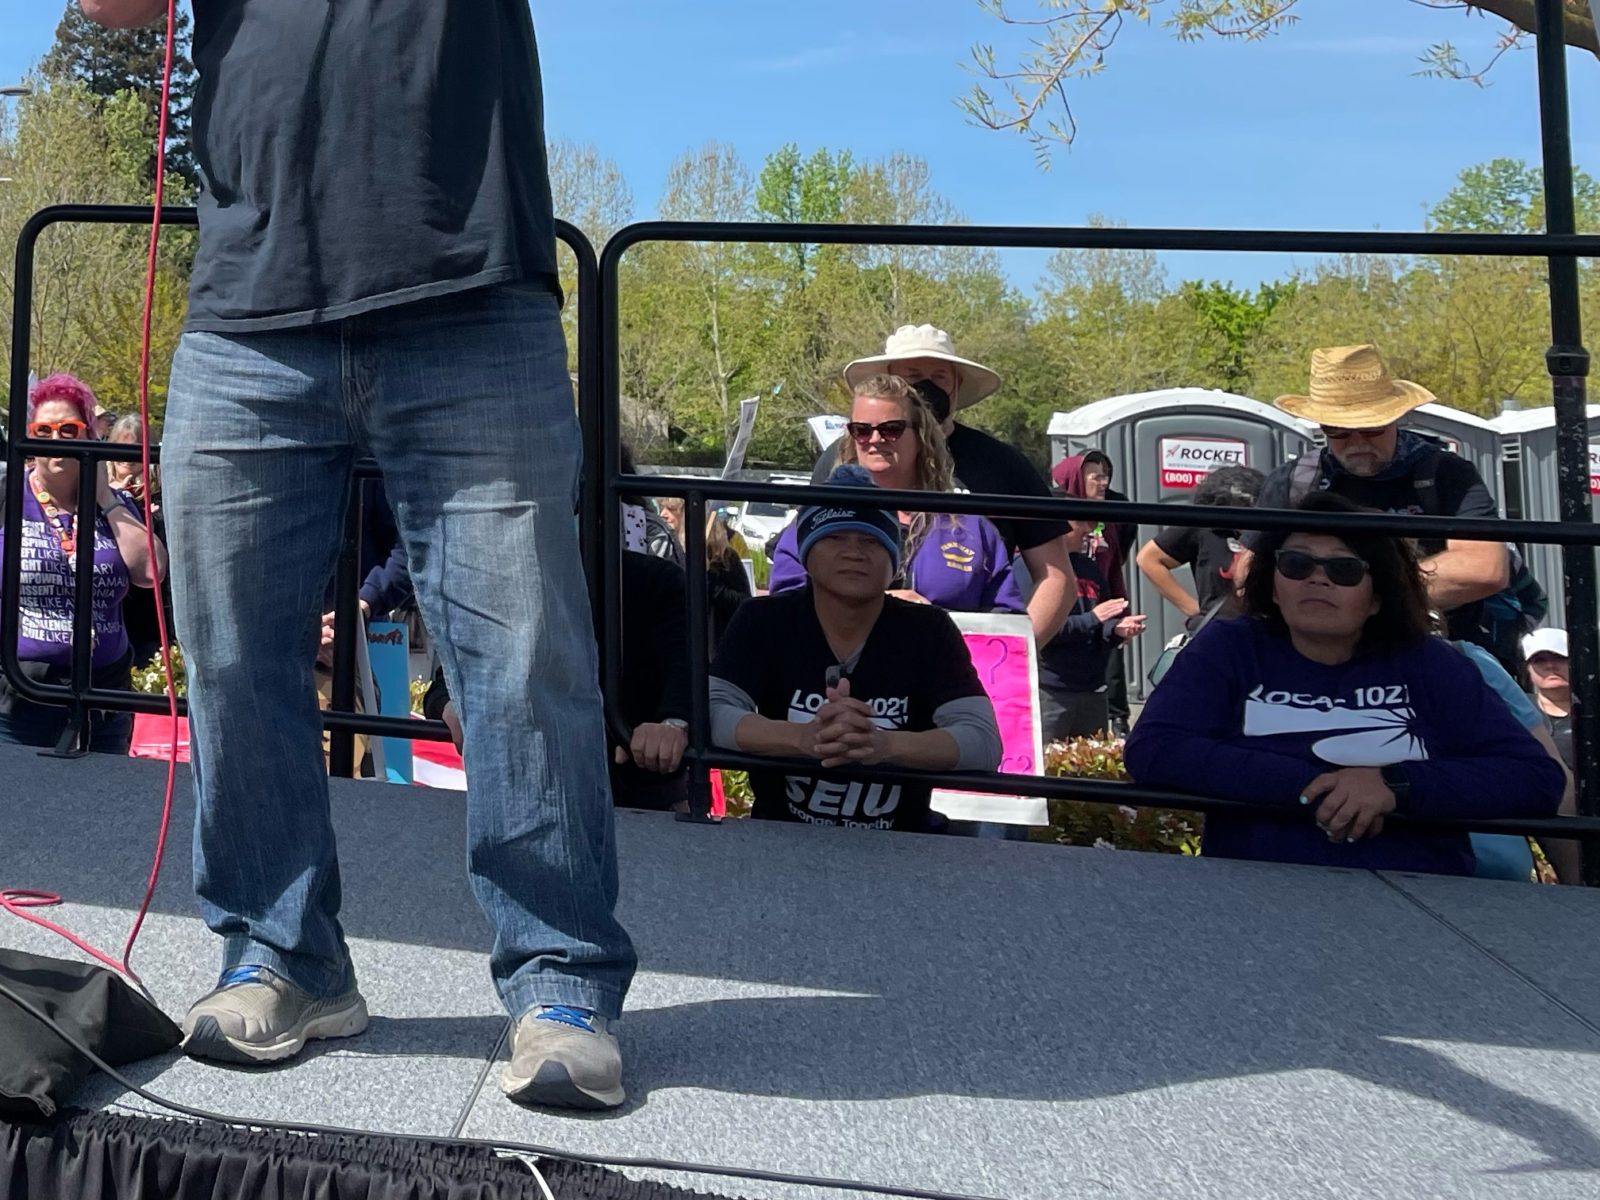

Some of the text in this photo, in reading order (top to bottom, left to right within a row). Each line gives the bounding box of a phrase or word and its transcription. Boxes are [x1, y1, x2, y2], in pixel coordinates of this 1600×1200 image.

[1180, 448, 1244, 464] ROCKET
[1164, 471, 1193, 485] (800)
[811, 507, 856, 530] Titleist
[38, 549, 60, 561] LIKE
[45, 561, 67, 574] LIKE
[40, 596, 62, 609] LIKE
[46, 631, 70, 644] LIKE
[785, 775, 902, 818] SEIU
